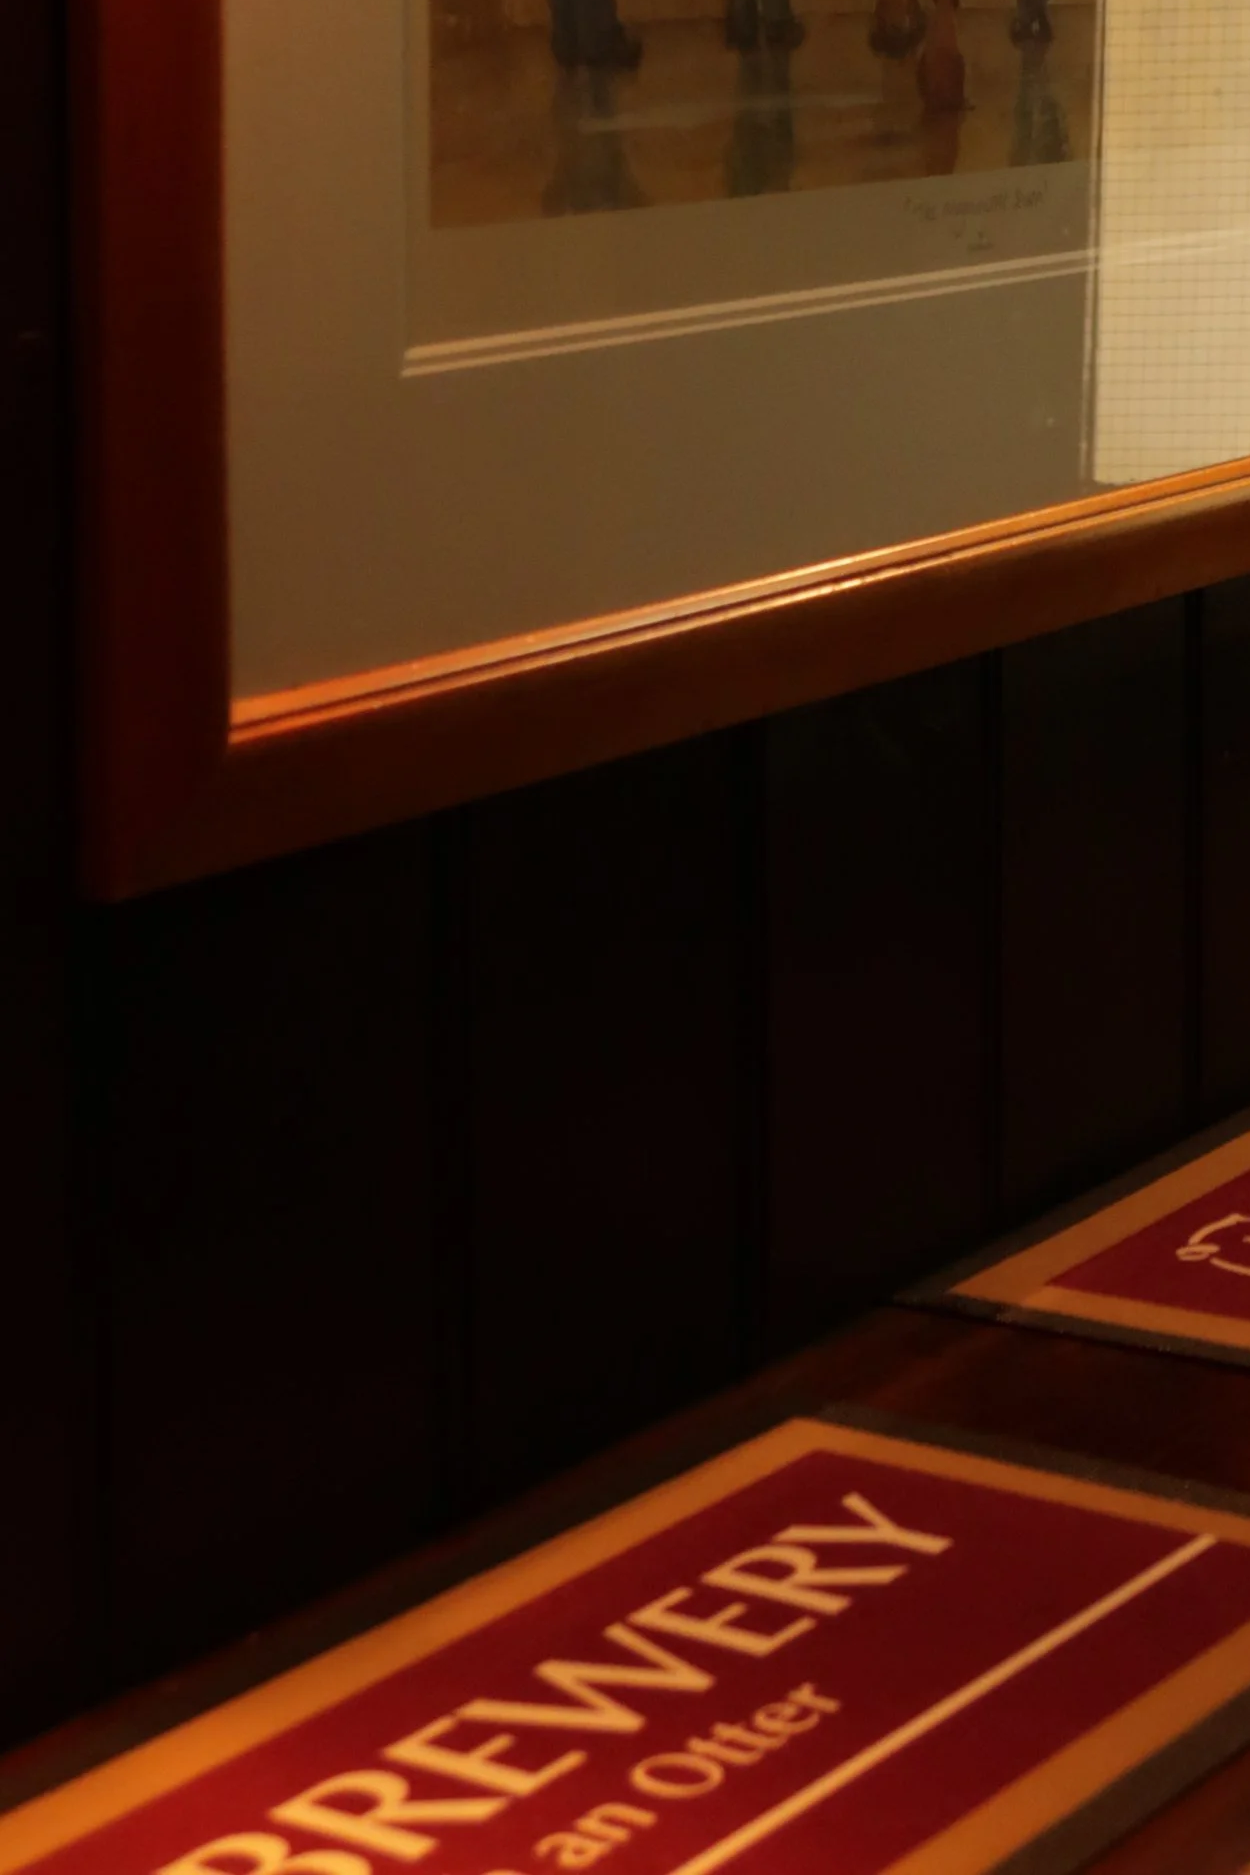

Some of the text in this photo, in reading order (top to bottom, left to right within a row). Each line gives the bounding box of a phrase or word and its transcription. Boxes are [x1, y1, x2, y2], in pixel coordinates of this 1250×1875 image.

[152, 1490, 955, 1875] BREWERY
[532, 1680, 843, 1871] an Otter
